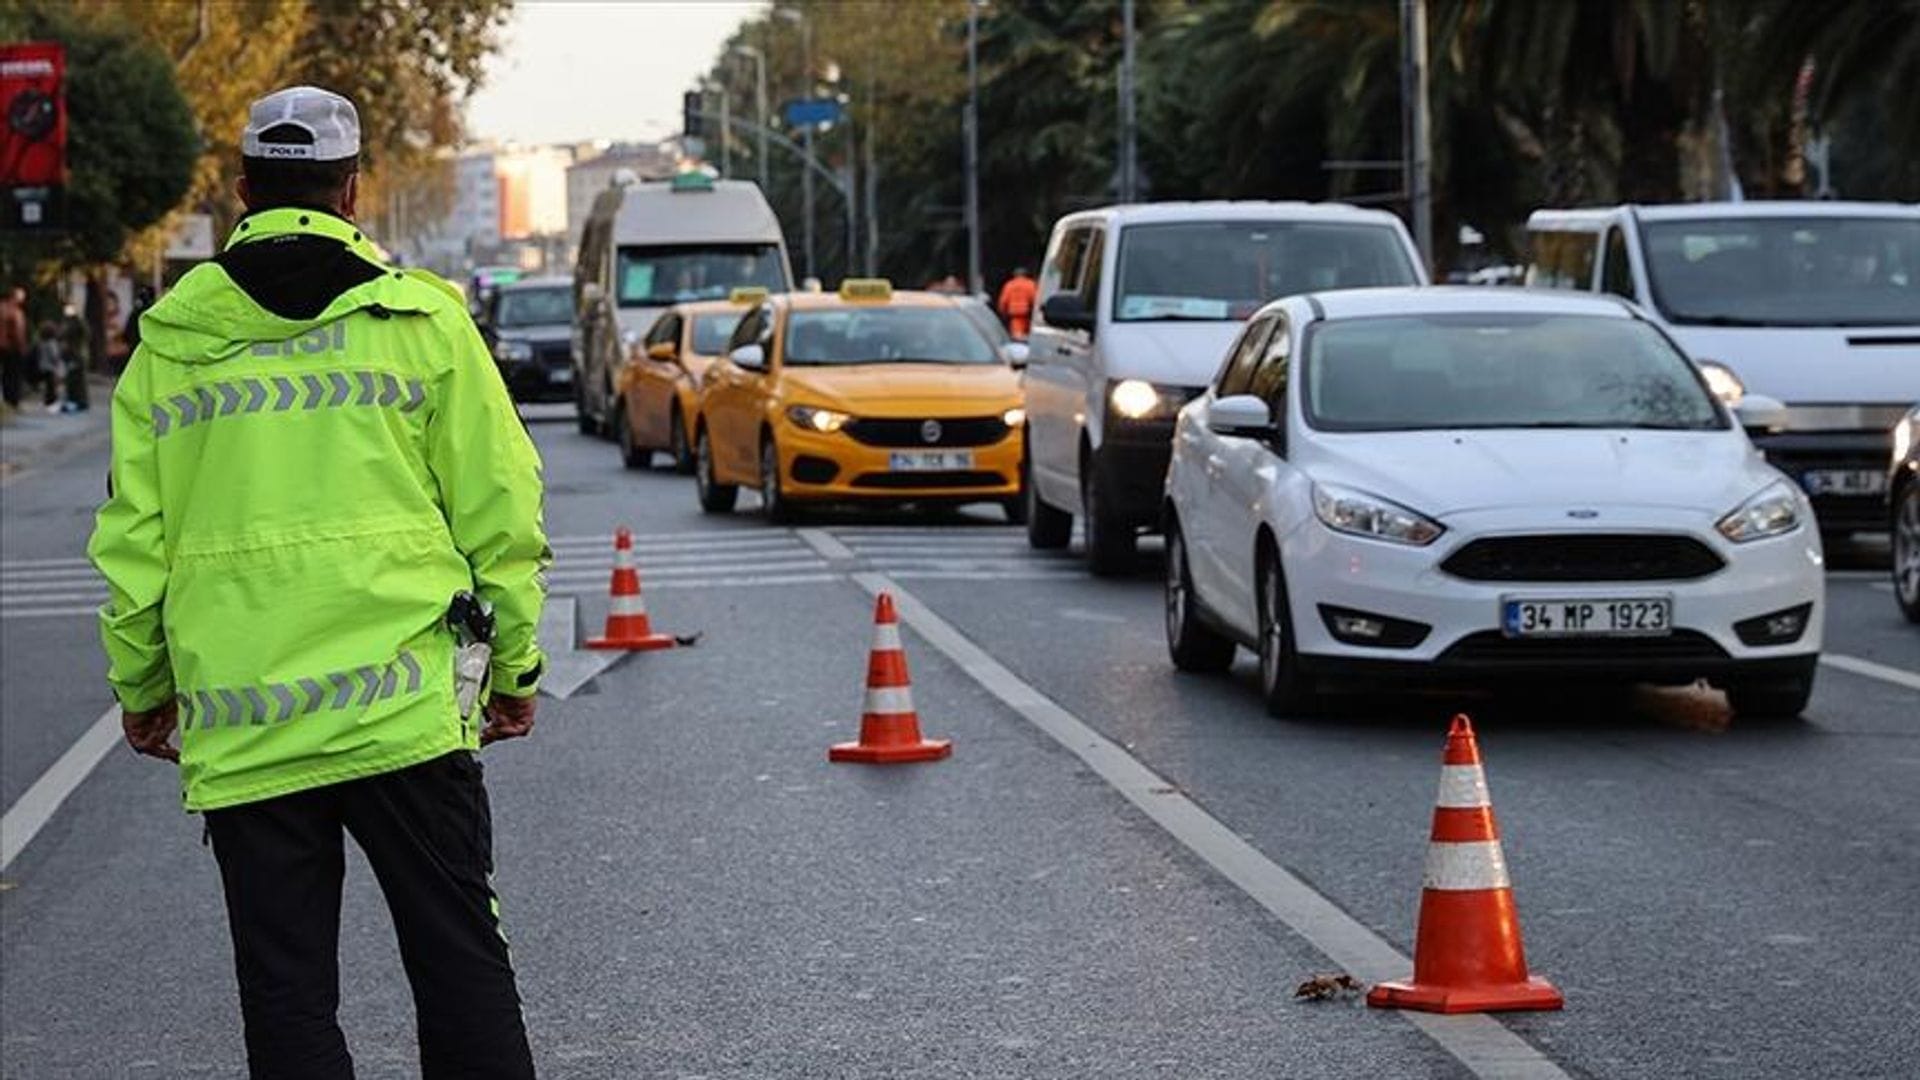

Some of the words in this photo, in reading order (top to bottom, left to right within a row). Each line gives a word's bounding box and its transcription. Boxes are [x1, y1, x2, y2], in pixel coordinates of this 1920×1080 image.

[1522, 604, 1552, 629] 34
[1564, 604, 1594, 629] MP
[1607, 603, 1664, 629] 1923
